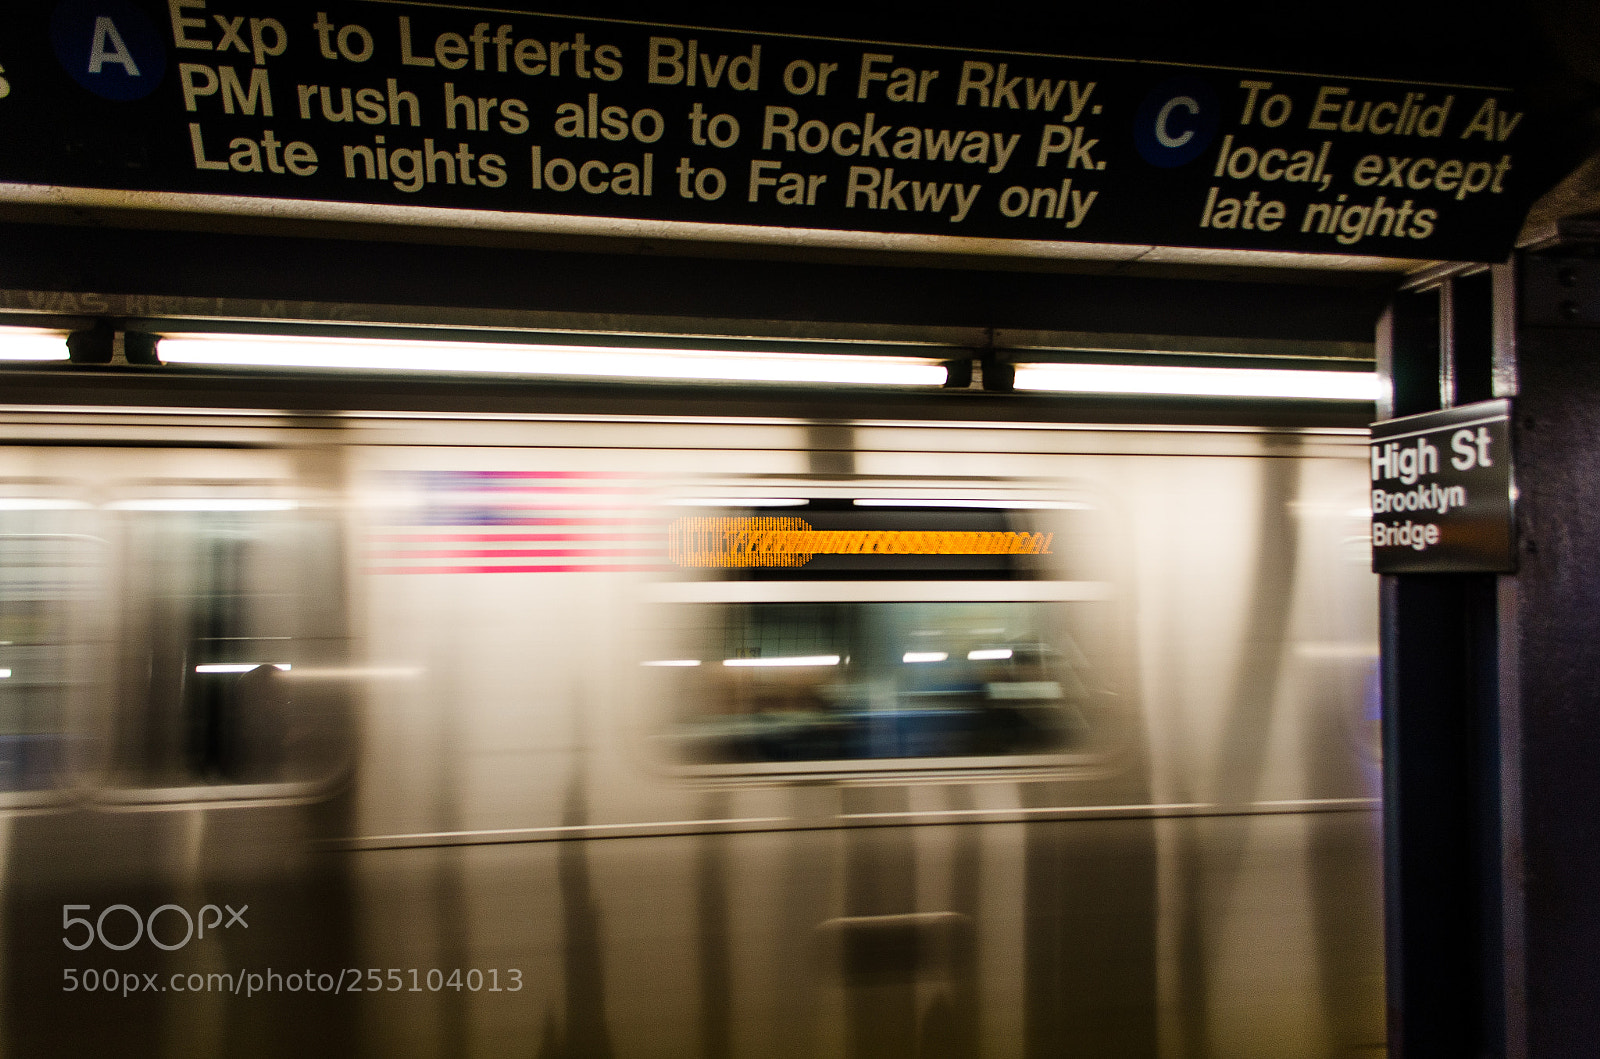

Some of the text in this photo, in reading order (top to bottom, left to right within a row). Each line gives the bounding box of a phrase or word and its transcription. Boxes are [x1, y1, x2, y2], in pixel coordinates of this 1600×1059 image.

[88, 17, 140, 76] A
[169, 0, 1102, 122] Exp to Lefferts Blvd or Far Rkwy.
[179, 63, 1106, 173] PM rush hrs also to Rockaway Pk.
[1155, 96, 1199, 148] C
[1239, 80, 1523, 141] To Euclid Av
[189, 123, 1098, 228] Late nights local to Far Rkwy only
[1215, 135, 1510, 201] local, except
[1201, 187, 1437, 244] late nights
[1372, 427, 1493, 485] High St
[1372, 483, 1465, 514] Brooklyn
[1372, 520, 1440, 550] Bridge
